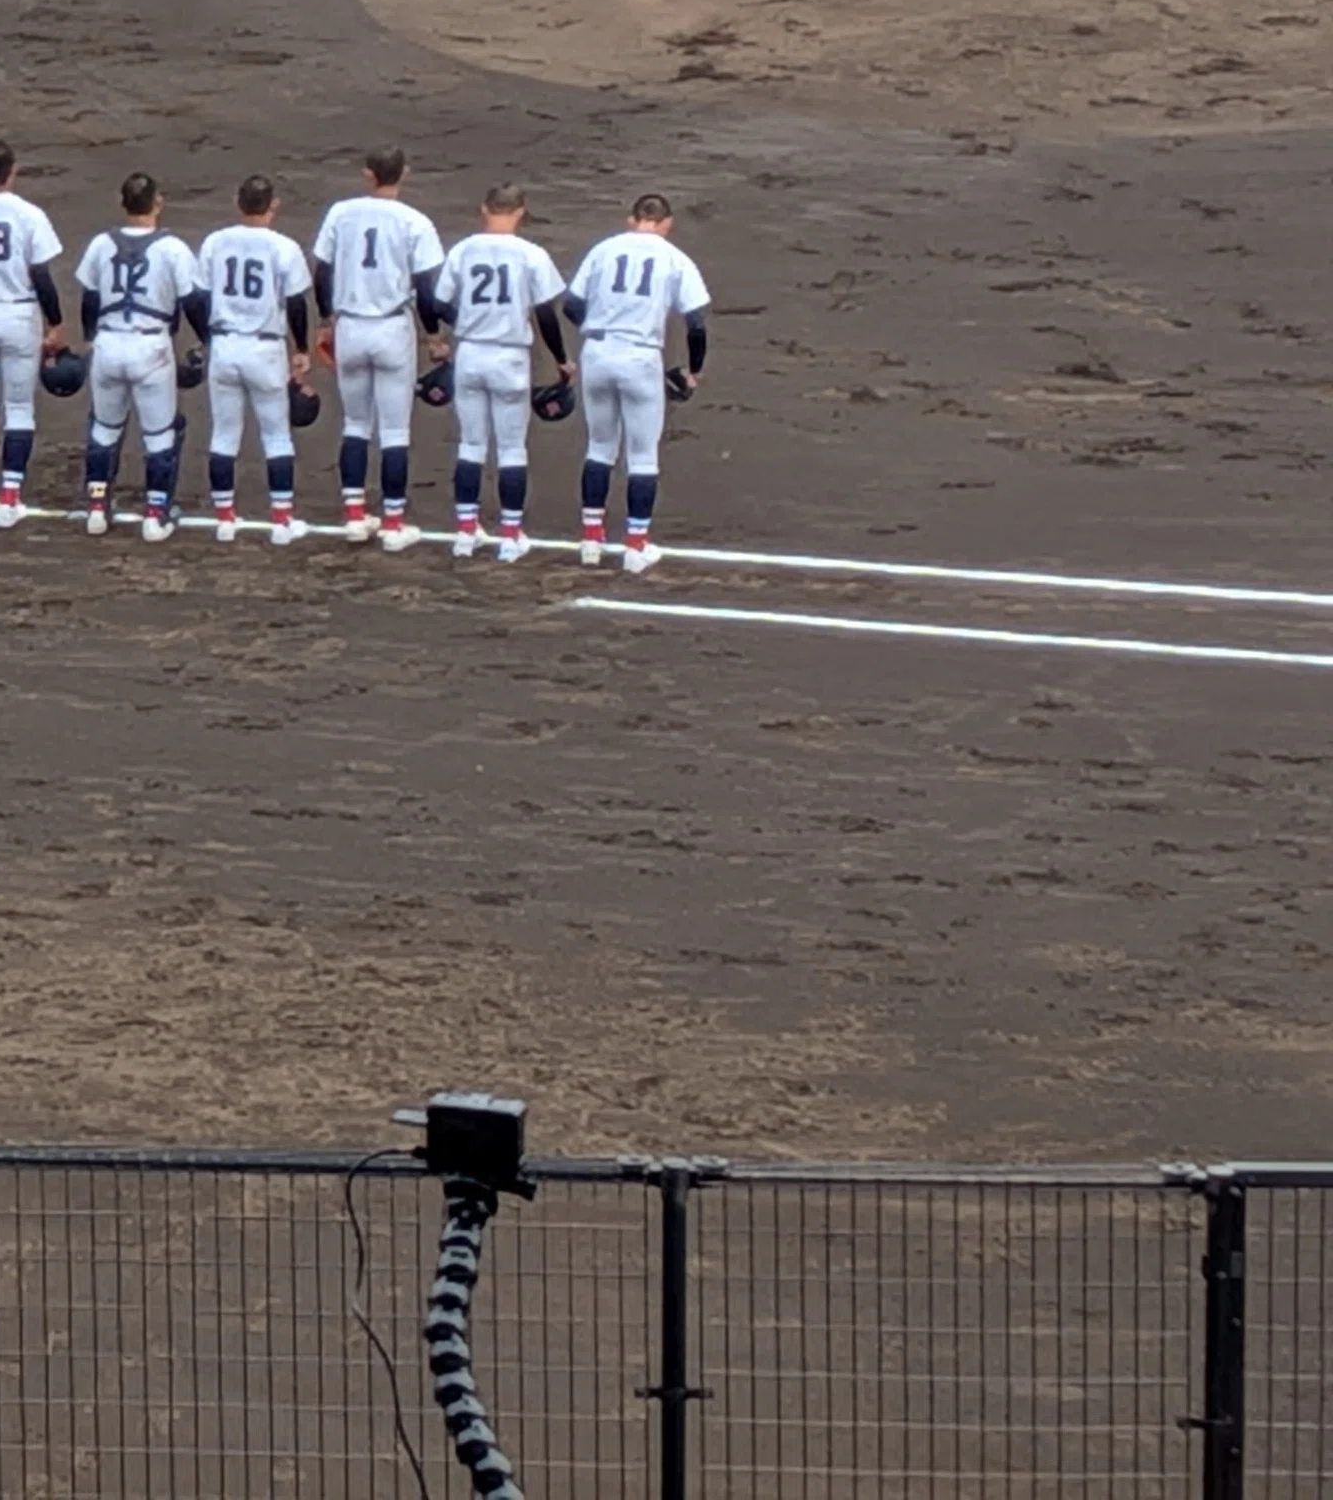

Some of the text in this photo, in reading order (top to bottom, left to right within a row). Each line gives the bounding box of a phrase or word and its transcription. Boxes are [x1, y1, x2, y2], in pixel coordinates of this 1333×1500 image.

[362, 228, 377, 269] 1
[223, 257, 263, 299] 16
[471, 265, 511, 305] 21
[611, 255, 653, 297] 11
